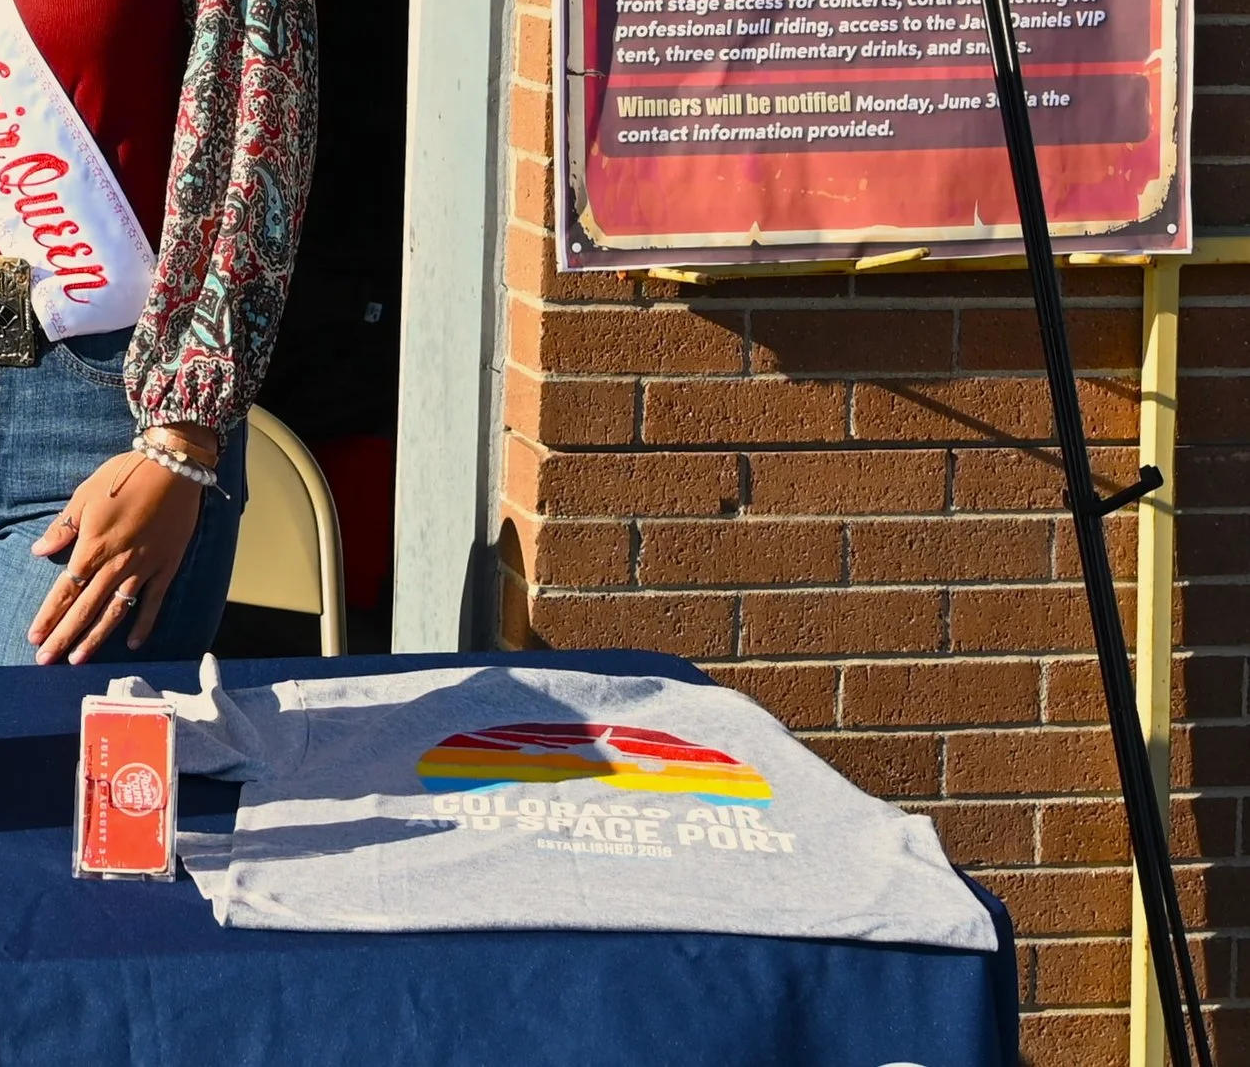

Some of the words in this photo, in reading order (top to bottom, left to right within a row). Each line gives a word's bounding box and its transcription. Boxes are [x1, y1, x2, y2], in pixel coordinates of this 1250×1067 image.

[615, 20, 732, 42] professional
[736, 18, 770, 35] bull
[775, 18, 834, 37] riding,
[839, 17, 898, 32] access
[903, 16, 921, 32] to
[926, 14, 956, 31] the
[1010, 12, 1071, 28] Daniels
[1076, 10, 1106, 27] VIP
[617, 47, 661, 65] tent,
[666, 45, 715, 61] three
[719, 43, 857, 64] complimentary
[861, 40, 923, 59] drinks,
[927, 38, 962, 55] and
[617, 95, 701, 118] Winners
[705, 94, 742, 115] will
[747, 93, 771, 115] be
[775, 91, 850, 113] notified
[856, 94, 935, 116] Monday,
[938, 93, 981, 109] June
[1042, 90, 1070, 106] the
[617, 126, 688, 144] contact
[692, 123, 803, 142] information
[807, 120, 894, 142] provided.
[432, 795, 672, 820] COLORADO
[685, 805, 768, 830] AIR
[404, 814, 500, 832] AND
[516, 815, 664, 845] SPACE
[676, 823, 797, 854] PORT
[537, 839, 634, 857] ESTABLISHED
